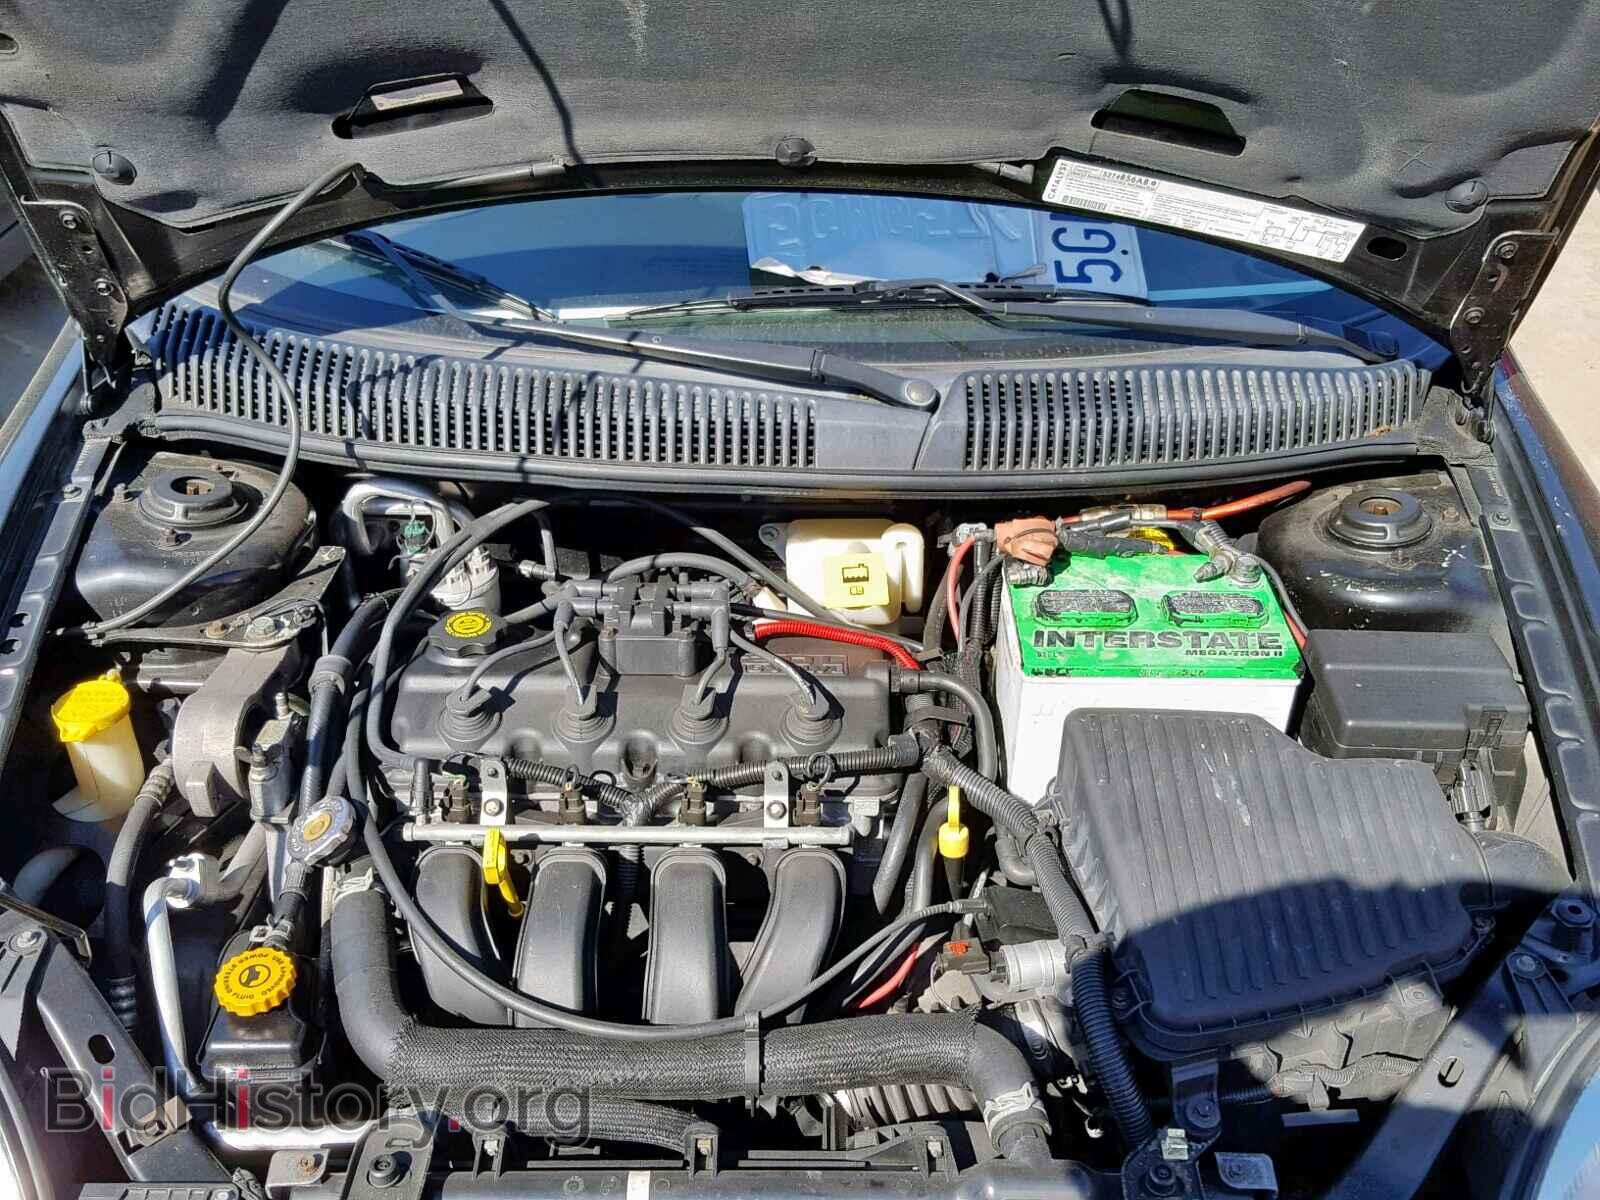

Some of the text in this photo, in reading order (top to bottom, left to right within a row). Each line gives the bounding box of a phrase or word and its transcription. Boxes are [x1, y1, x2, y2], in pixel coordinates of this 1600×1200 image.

[1047, 162, 1068, 200] CATALYST
[1049, 213, 1122, 283] 5G
[1033, 630, 1283, 649] INTERSTATE
[1185, 649, 1271, 657] MEGA-TRON
